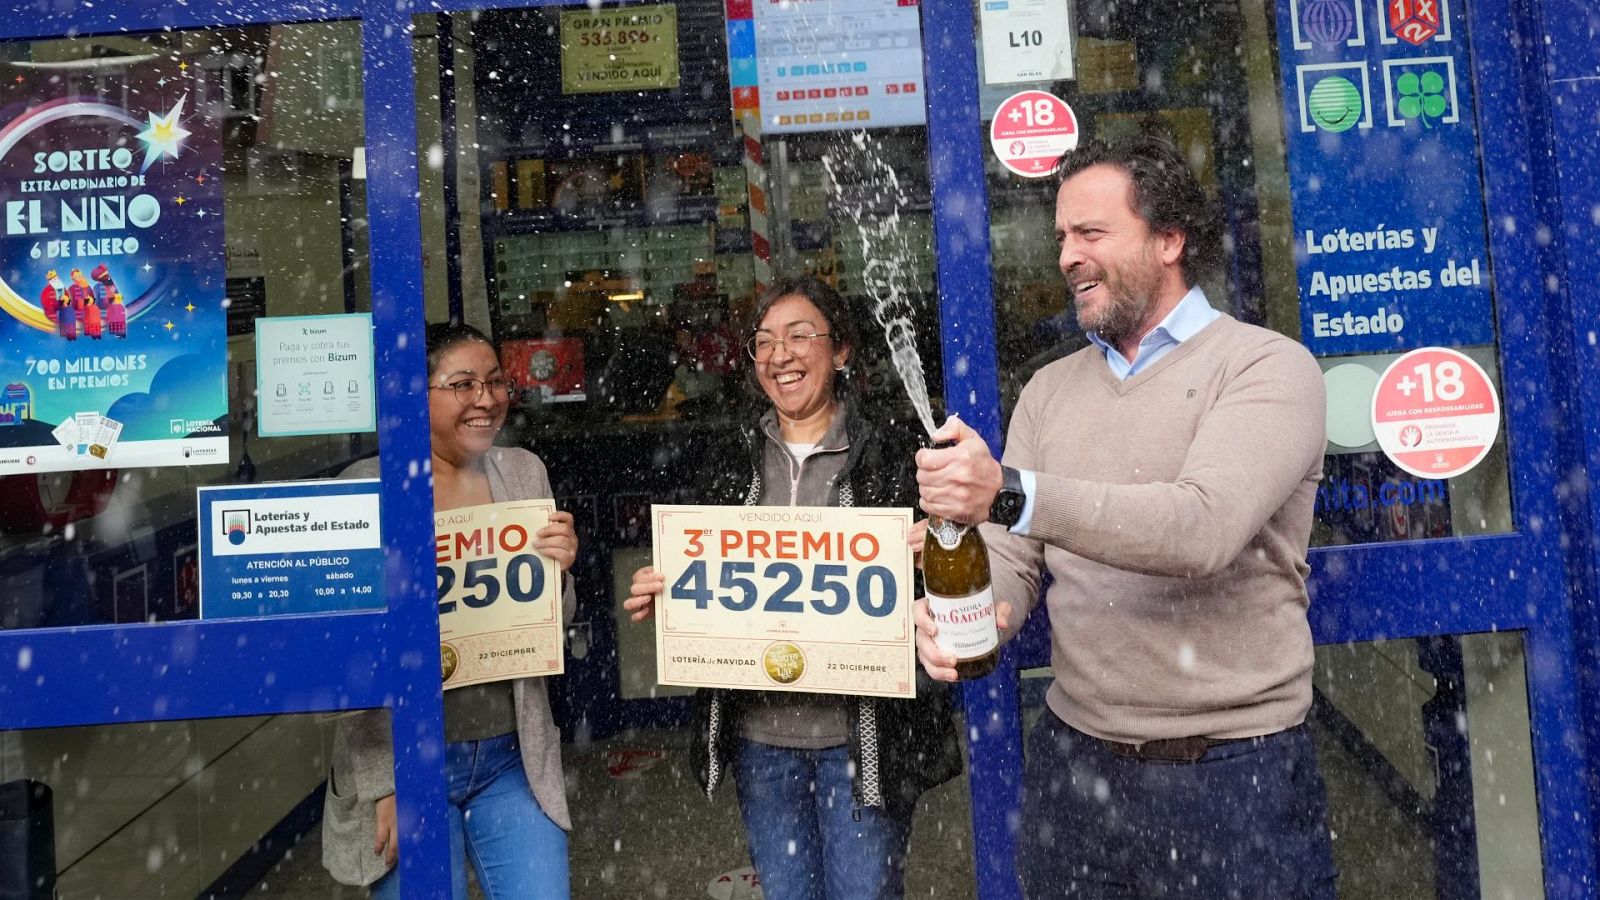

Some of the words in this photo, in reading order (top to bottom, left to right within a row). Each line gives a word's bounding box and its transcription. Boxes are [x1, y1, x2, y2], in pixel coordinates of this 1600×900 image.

[573, 19, 611, 29] GRAN
[615, 14, 662, 27] PREMIO
[1009, 30, 1042, 48] L10
[578, 70, 629, 81] VENDIDO
[1008, 99, 1055, 127] +18
[33, 147, 133, 174] SORTEO
[21, 176, 128, 192] EXTRAORDINARIO
[130, 175, 146, 187] DE
[6, 199, 49, 235] EL
[61, 193, 161, 232] NIÑO
[1305, 223, 1414, 255] Loterías
[1421, 226, 1438, 254] y
[30, 241, 41, 259] 6
[47, 240, 70, 258] DE
[77, 236, 139, 257] ENERO
[1309, 266, 1432, 302] Apuestas
[1440, 259, 1481, 289] del
[1313, 308, 1405, 338] Estado
[279, 341, 301, 352] Paga
[303, 343, 309, 351] y
[311, 340, 334, 350] cobra
[336, 340, 351, 349] tus
[26, 358, 61, 376] 700
[65, 354, 147, 374] MILLONES
[272, 355, 308, 366] premios
[310, 355, 325, 363] con
[328, 352, 357, 362] Bizum
[48, 377, 66, 391] EN
[70, 374, 129, 389] PREMIOS
[1396, 360, 1465, 403] +18
[1424, 403, 1484, 414] RESPONSABILIDAD
[186, 425, 222, 433] NACIONAL
[254, 511, 301, 522] Loterías
[303, 512, 310, 523] y
[738, 512, 791, 522] VENDIDO
[794, 512, 822, 523] AQUÍ
[255, 524, 308, 536] Apuestas
[310, 521, 328, 532] del
[330, 521, 370, 532] Estado
[720, 529, 880, 562] PREMIO
[246, 558, 293, 570] ATENCIÓN
[295, 558, 307, 567] AL
[309, 555, 350, 567] PÚBLICO
[231, 576, 252, 585] lunes
[260, 575, 288, 584] viernes
[325, 571, 354, 580] sábado
[315, 587, 335, 597] 10,00
[352, 585, 372, 595] 14,00
[436, 553, 545, 615] 250
[671, 559, 897, 618] 45250
[232, 591, 253, 600] 09,30
[269, 589, 289, 599] 20,30
[937, 613, 949, 624] EL
[491, 646, 537, 658] DICIEMBRE
[672, 655, 706, 665] LOTERÍA
[717, 658, 756, 667] NAVIDAD
[840, 664, 887, 673] DICIEMBRE
